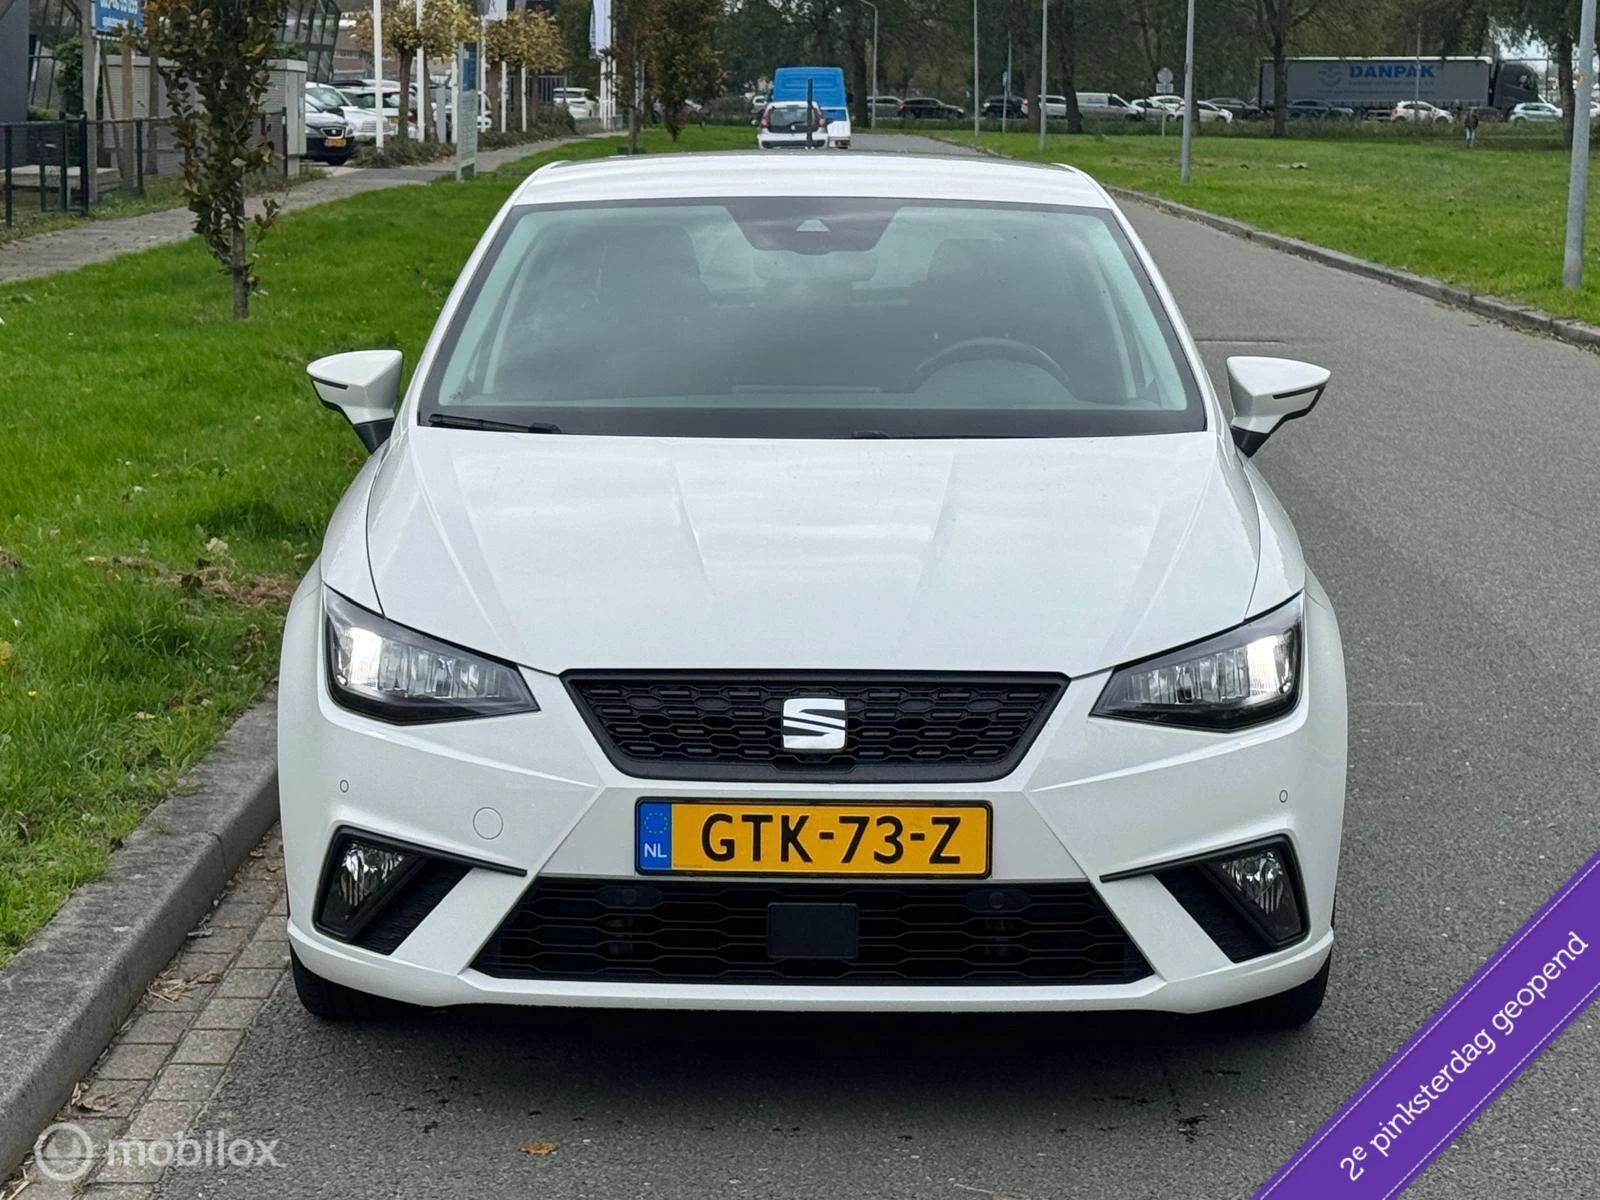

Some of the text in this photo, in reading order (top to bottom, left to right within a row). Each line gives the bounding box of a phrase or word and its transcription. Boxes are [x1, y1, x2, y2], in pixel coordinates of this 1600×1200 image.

[1350, 65, 1434, 78] DANPAK
[701, 813, 961, 865] GTK-73-Z
[643, 843, 667, 858] NL
